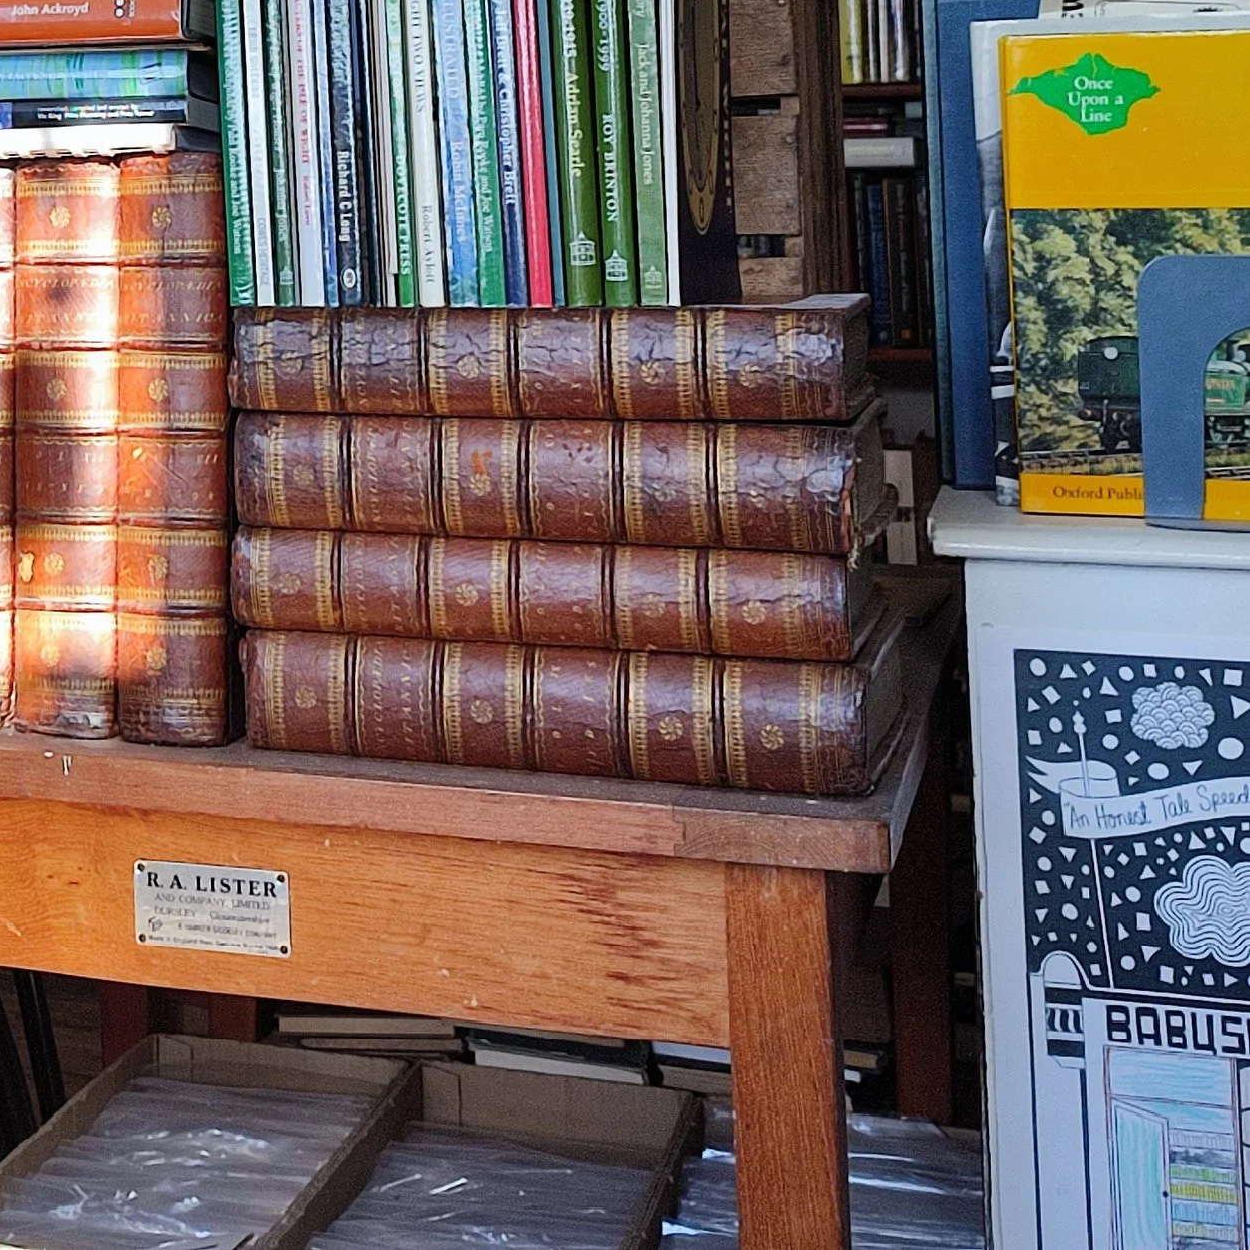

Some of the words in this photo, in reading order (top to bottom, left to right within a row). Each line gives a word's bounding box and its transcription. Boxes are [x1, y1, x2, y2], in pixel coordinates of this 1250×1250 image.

[11, 4, 39, 17] John
[41, 1, 89, 17] Ackroyd
[493, 8, 507, 32] Jeff
[413, 35, 424, 65] TWO
[495, 34, 508, 69] Brett
[636, 43, 650, 70] Jack
[297, 59, 305, 77] THE
[498, 72, 509, 85] &
[639, 71, 652, 95] and
[1073, 75, 1114, 91] Once
[298, 83, 307, 105] ISLE
[414, 69, 427, 114] VIEWS
[567, 71, 580, 124] Adrian
[1067, 90, 1110, 110] Upon
[1115, 94, 1125, 106] a
[299, 109, 309, 124] OF
[498, 88, 513, 167] Christopher
[601, 114, 615, 145] ROY
[638, 96, 653, 149] Johanna
[1080, 107, 1113, 124] Line
[300, 128, 310, 164] WIGHT
[570, 129, 585, 177] Searle
[337, 150, 352, 198] Richard
[452, 141, 464, 182] Robin
[640, 150, 656, 185] Jones
[231, 177, 241, 194] and
[395, 154, 409, 233] DOVECOTE
[503, 170, 516, 205] Brett
[604, 152, 619, 222] BRINTON
[232, 199, 241, 217] Joe
[339, 201, 351, 210] C
[453, 187, 468, 243] McInnes
[482, 195, 492, 213] Joe
[233, 219, 243, 254] Watson
[275, 212, 288, 242] Jones
[339, 212, 353, 242] Long
[422, 205, 433, 243] Robert
[483, 215, 494, 253] Watson
[398, 235, 411, 275] PRESS
[1052, 485, 1103, 500] Oxford
[1094, 800, 1152, 829] Honest
[1153, 792, 1193, 820] Tale
[147, 871, 164, 889] R.
[169, 874, 187, 890] A.
[196, 875, 277, 898] LISTER
[154, 893, 175, 903] AND
[179, 894, 226, 908] COMPANY
[231, 899, 271, 911] LIMITED
[1105, 1004, 1250, 1056] BABUS
